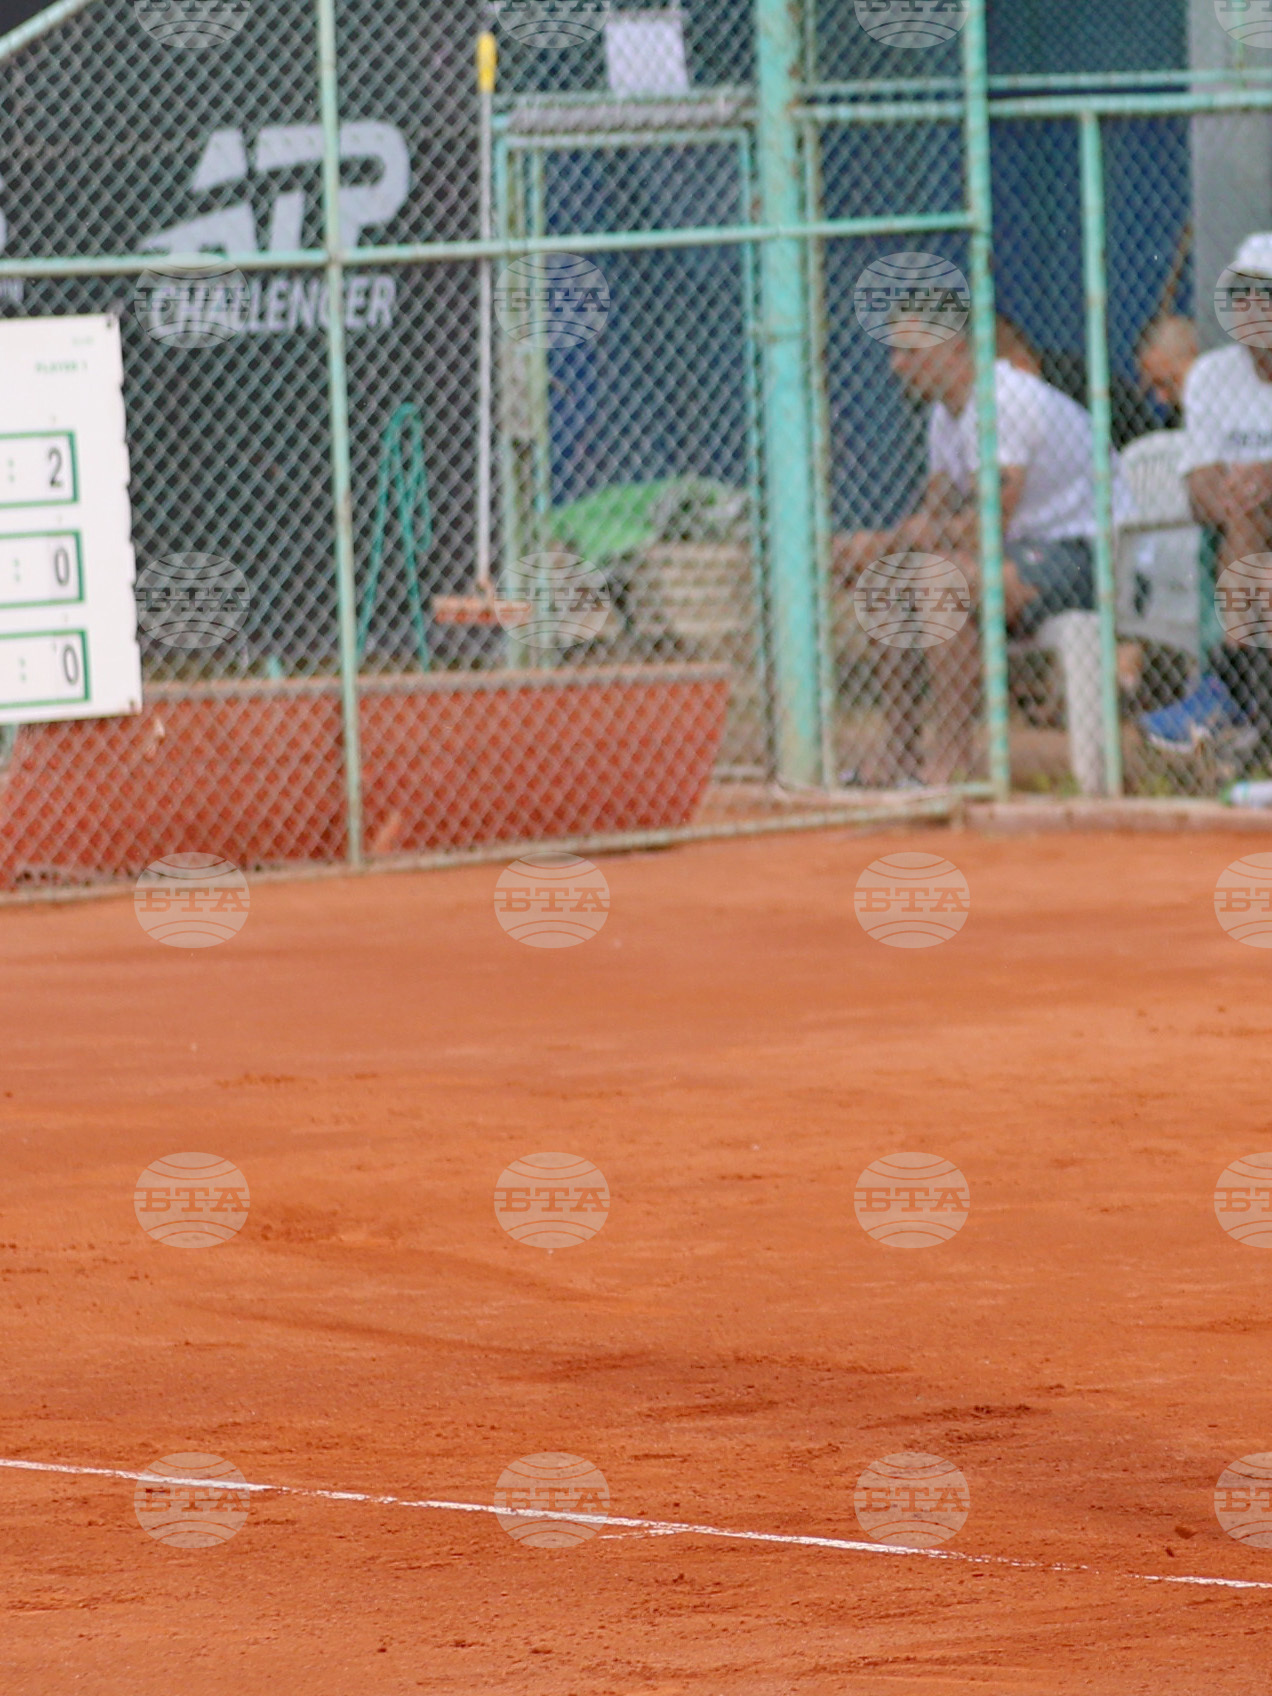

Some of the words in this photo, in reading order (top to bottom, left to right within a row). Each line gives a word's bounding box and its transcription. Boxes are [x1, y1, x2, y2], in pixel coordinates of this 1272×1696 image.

[47, 446, 64, 488] 2
[54, 546, 71, 587] 0
[63, 643, 80, 686] 0
